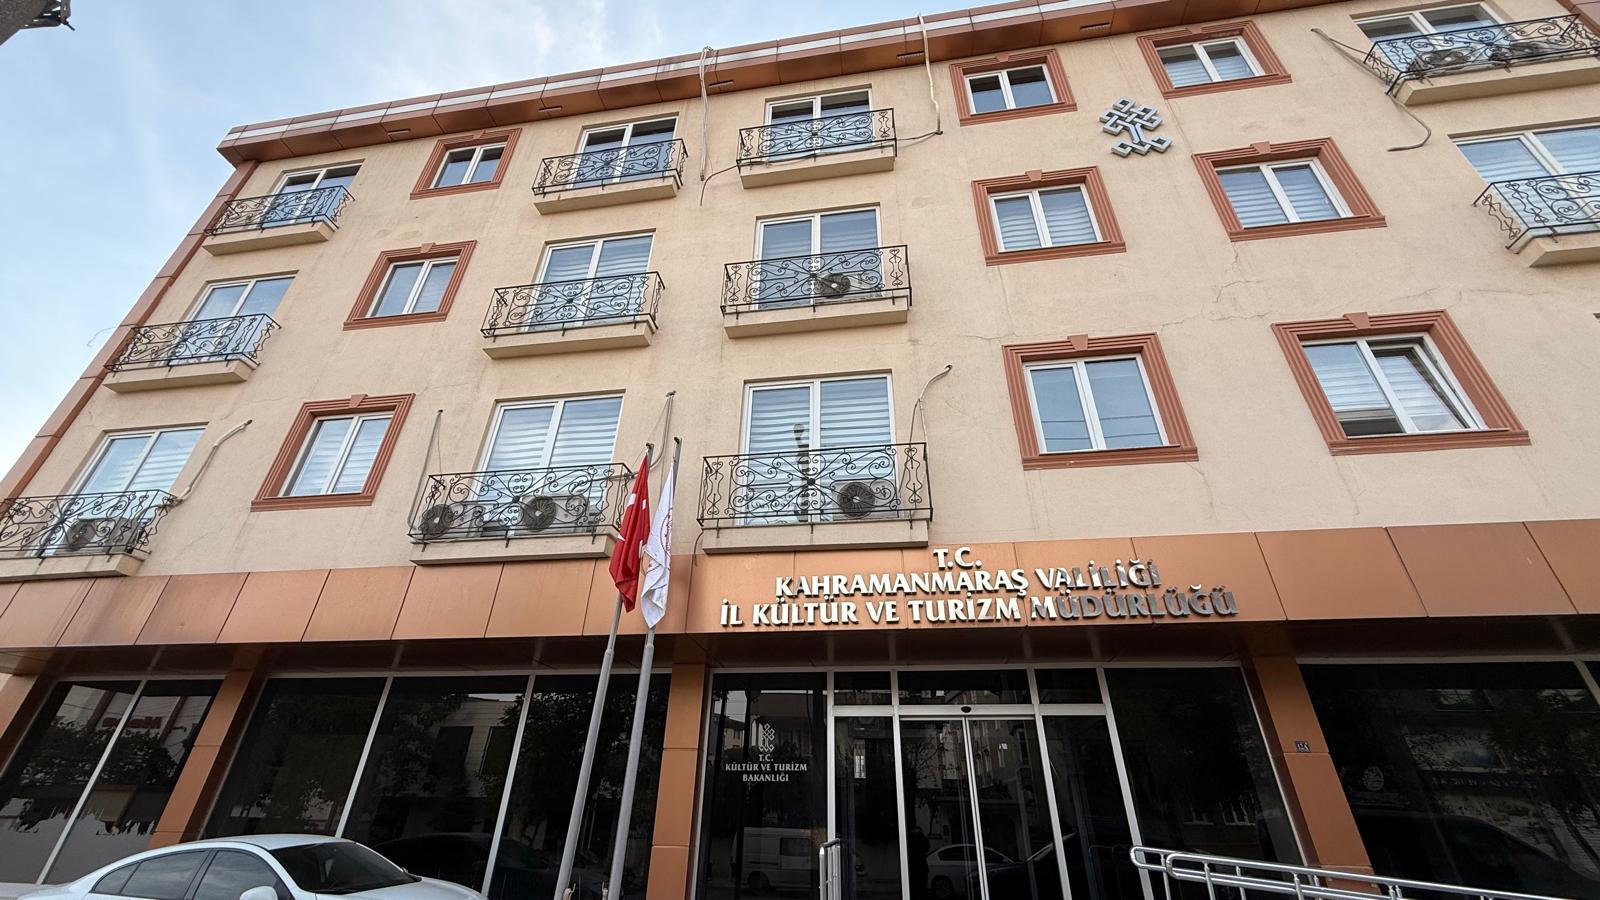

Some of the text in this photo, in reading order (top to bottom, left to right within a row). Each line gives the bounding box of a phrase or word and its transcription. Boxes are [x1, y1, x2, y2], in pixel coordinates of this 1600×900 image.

[933, 547, 982, 569] T.C.
[775, 559, 1162, 597] KAHRAMANMARAŞ VALİLİĞİ
[721, 584, 1238, 626] İL KÜLTÜR VE TURİZM MÜDÜRLÜĞÜ
[725, 761, 807, 771] KÜLTÜR VE TURİZM
[758, 754, 774, 762] T.C.
[742, 773, 789, 782] BAKANLIĞI
